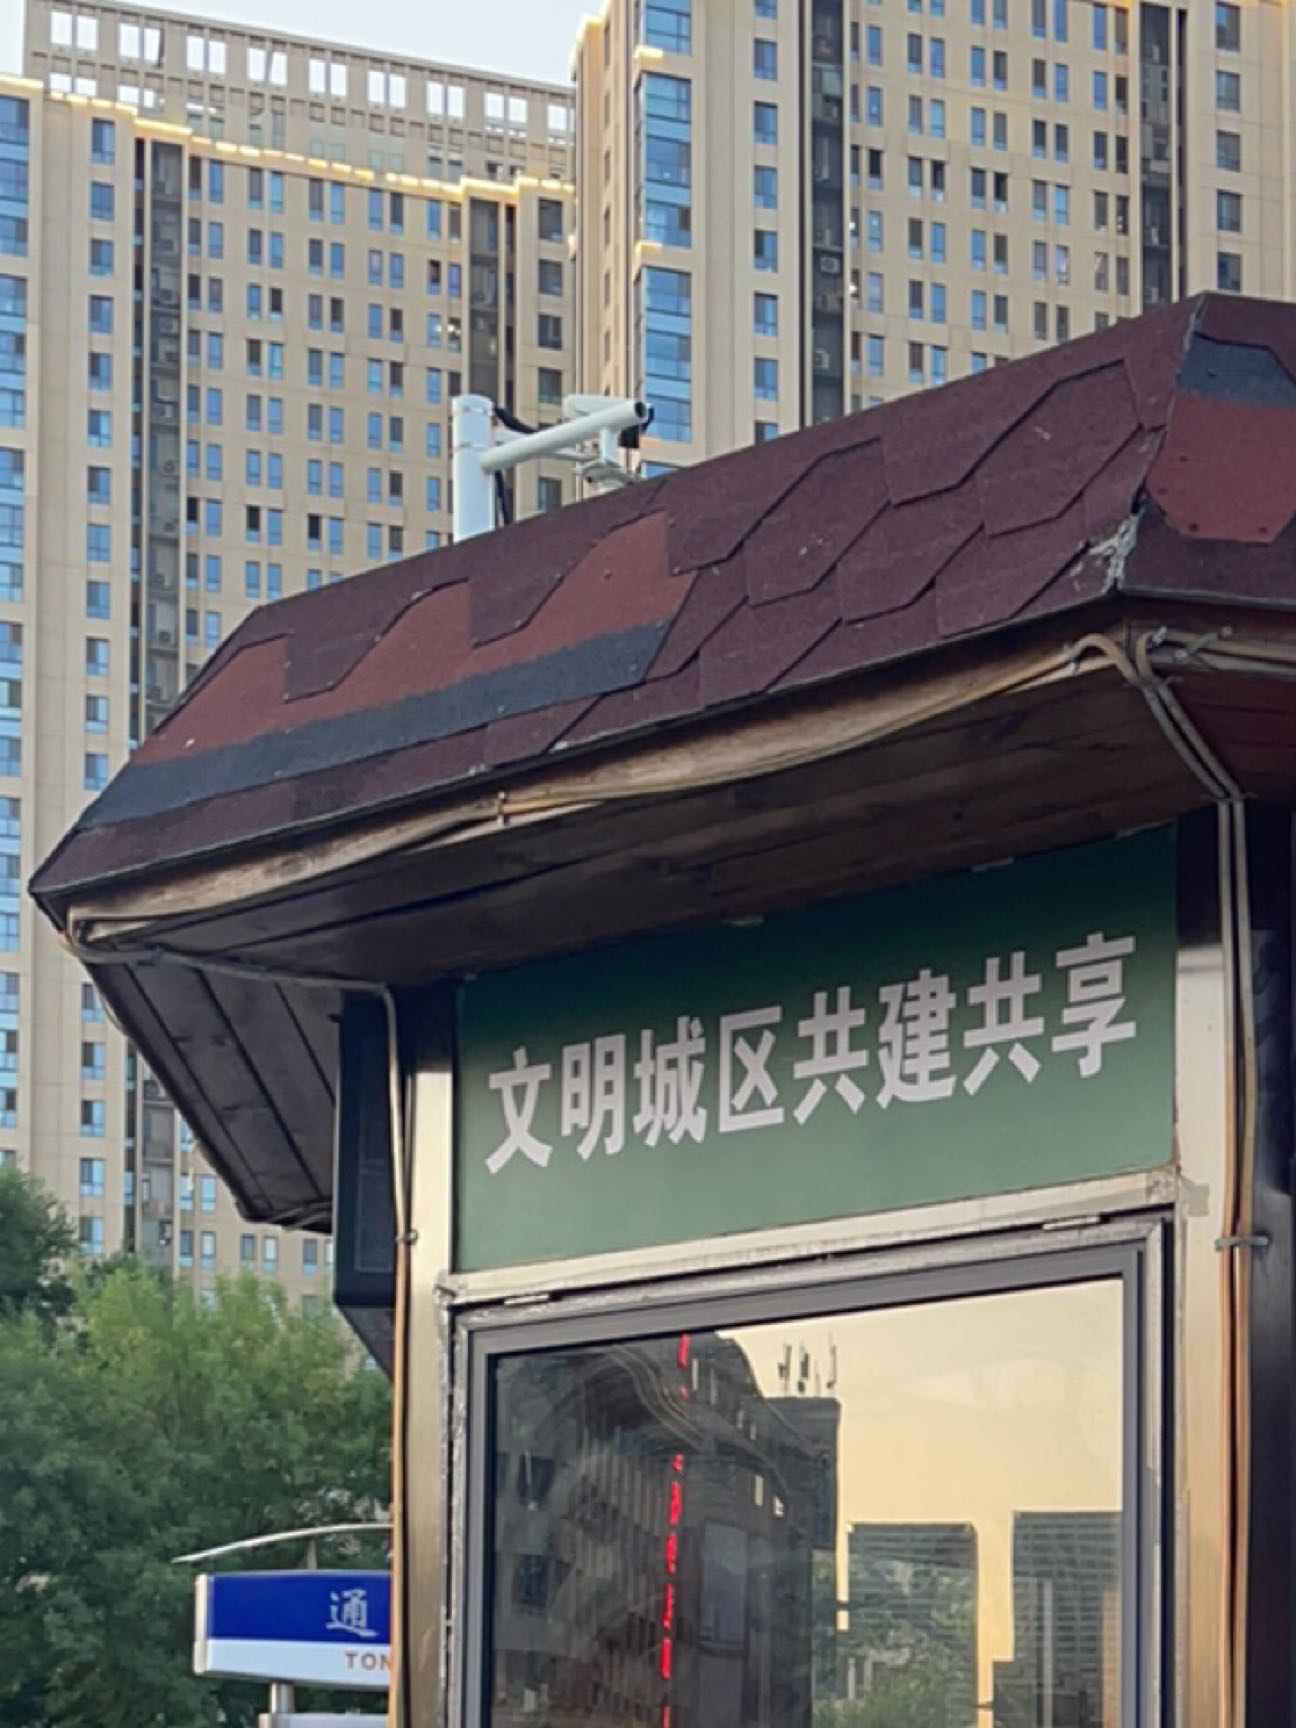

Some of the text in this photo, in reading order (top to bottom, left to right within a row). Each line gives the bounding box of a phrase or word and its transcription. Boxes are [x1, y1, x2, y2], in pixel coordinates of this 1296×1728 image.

[484, 931, 1138, 1176] 文明城区共建共享
[325, 1588, 379, 1638] 通
